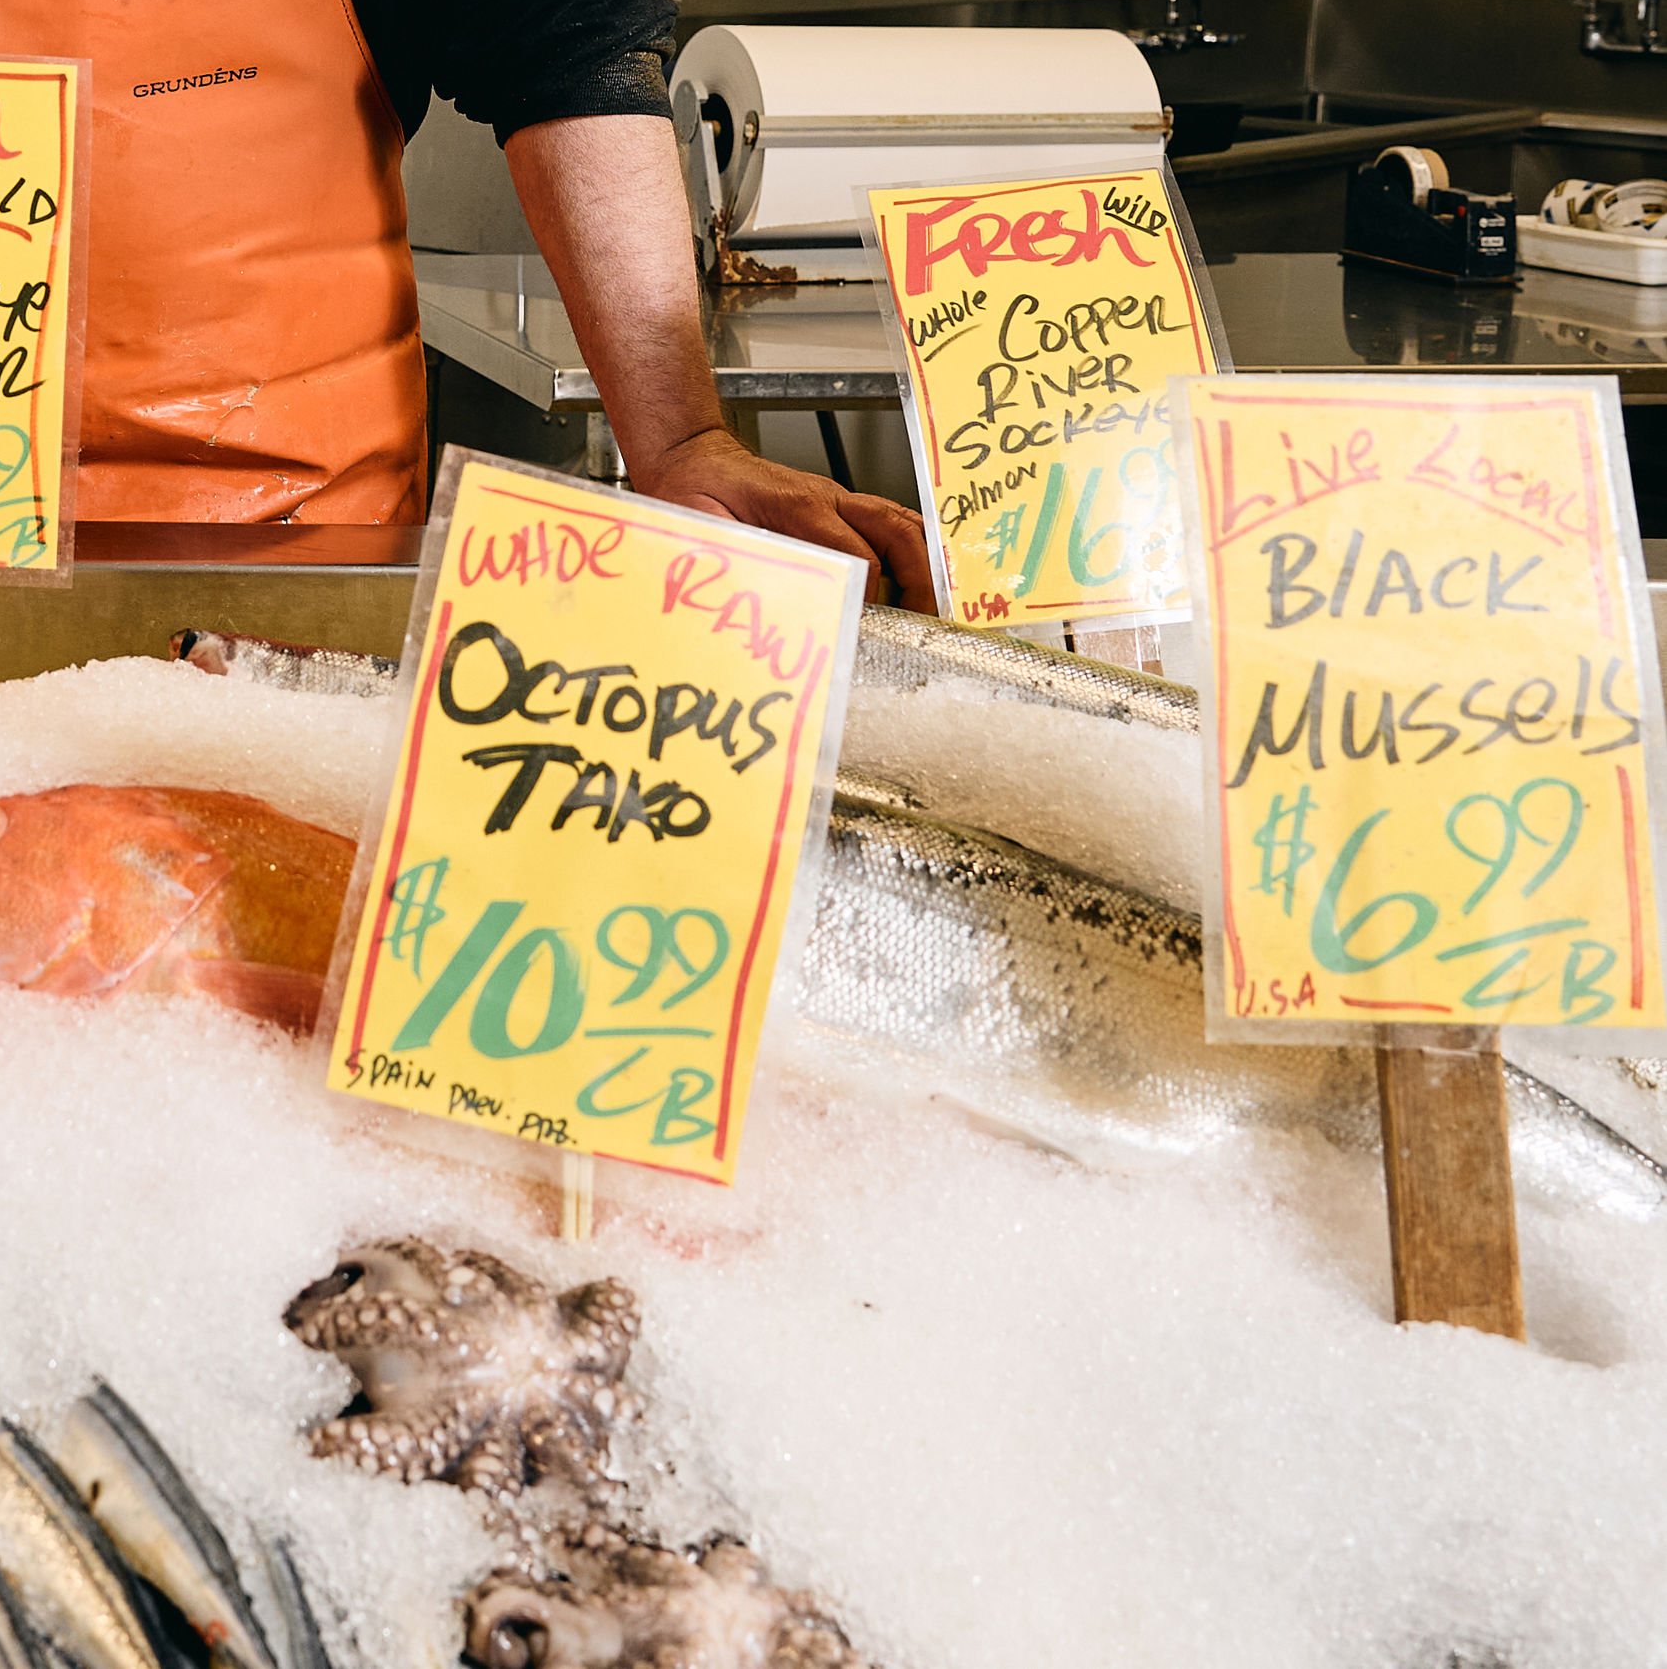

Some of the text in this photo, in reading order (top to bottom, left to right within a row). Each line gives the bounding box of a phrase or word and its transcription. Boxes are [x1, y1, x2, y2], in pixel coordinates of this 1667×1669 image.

[133, 67, 258, 98] GRUNDÉNS
[662, 549, 815, 681] RAW
[962, 592, 1011, 622] USA
[462, 743, 711, 843] TAKO
